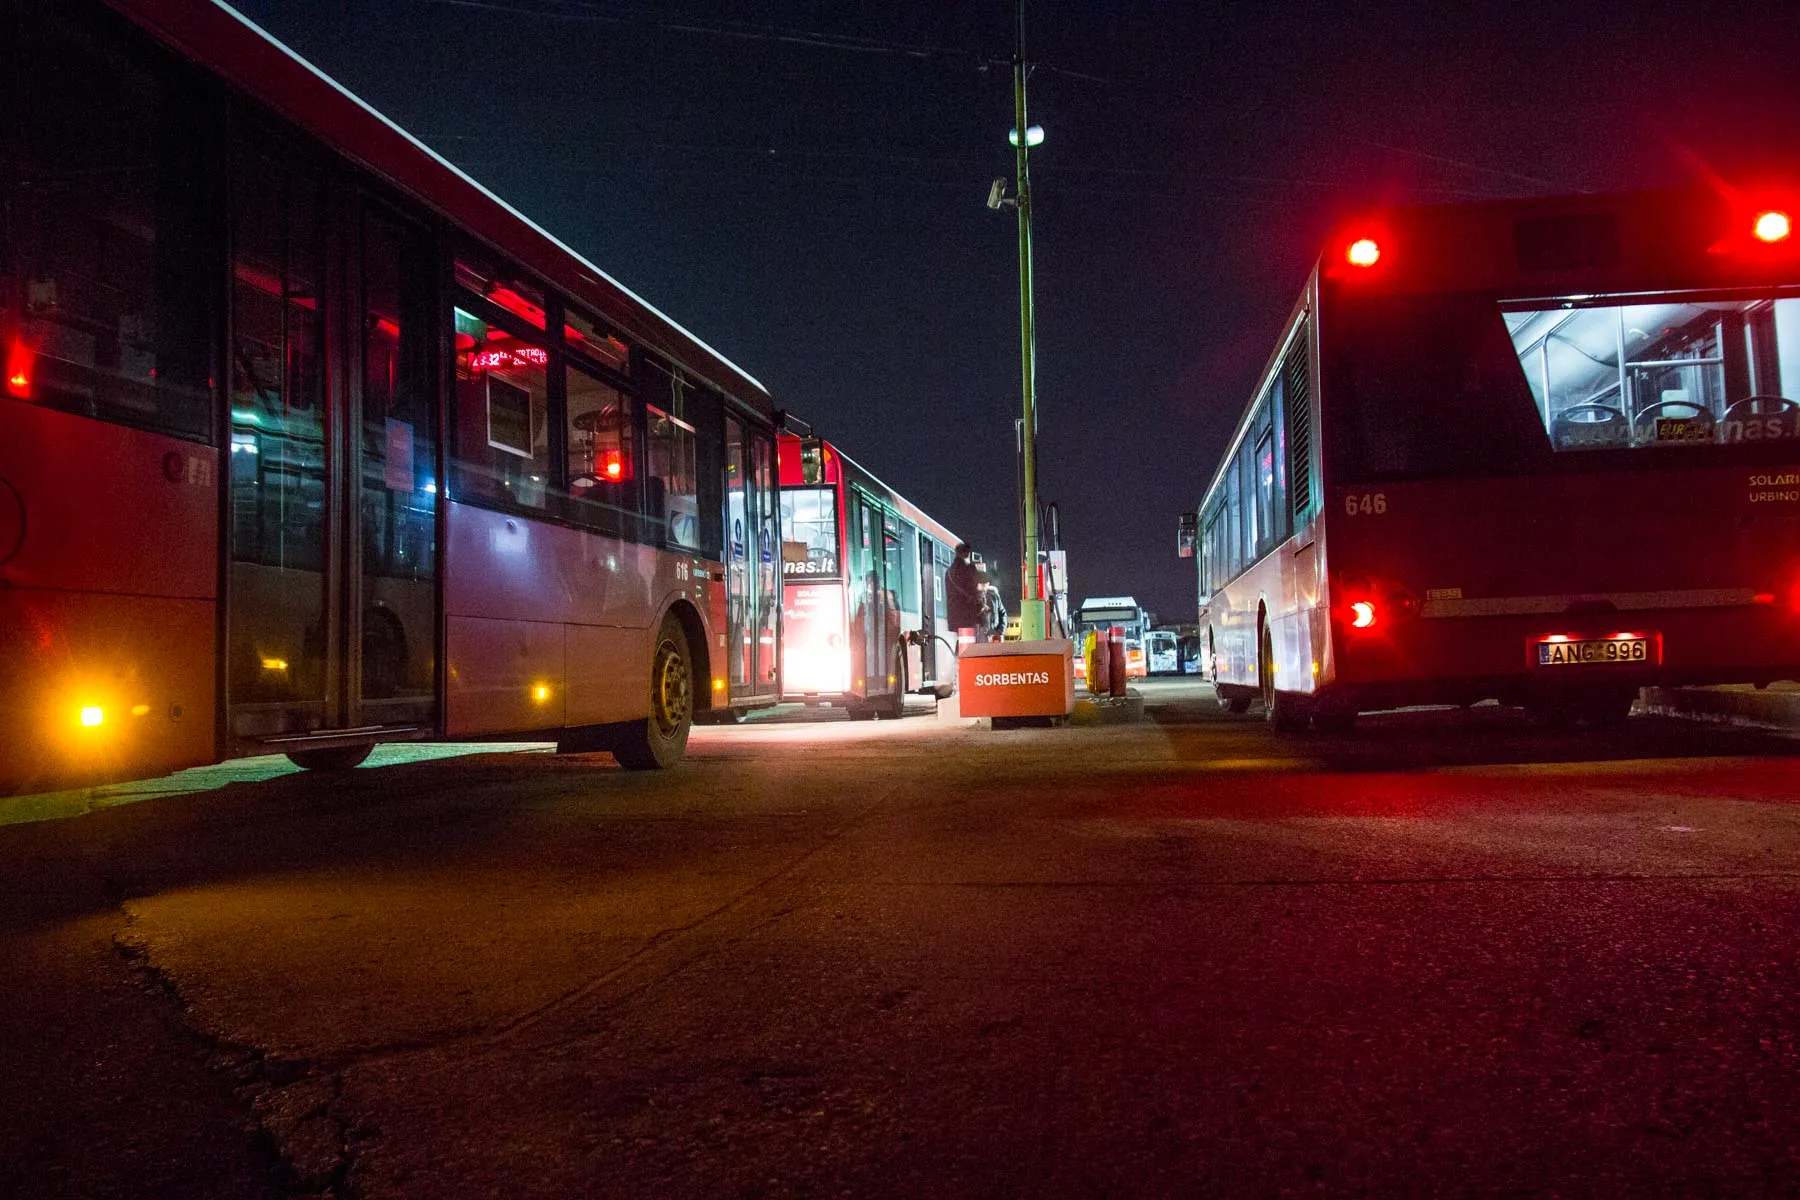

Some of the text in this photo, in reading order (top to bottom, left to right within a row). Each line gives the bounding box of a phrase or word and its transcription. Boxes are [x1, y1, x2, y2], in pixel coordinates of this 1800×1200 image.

[1749, 474, 1800, 486] SOLARI
[1345, 494, 1387, 515] 646
[1749, 491, 1800, 502] URBINO
[676, 561, 688, 581] 616
[783, 557, 835, 575] nas.lt
[1552, 641, 1643, 663] ANG 996
[975, 671, 1049, 686] SORBENTAS
